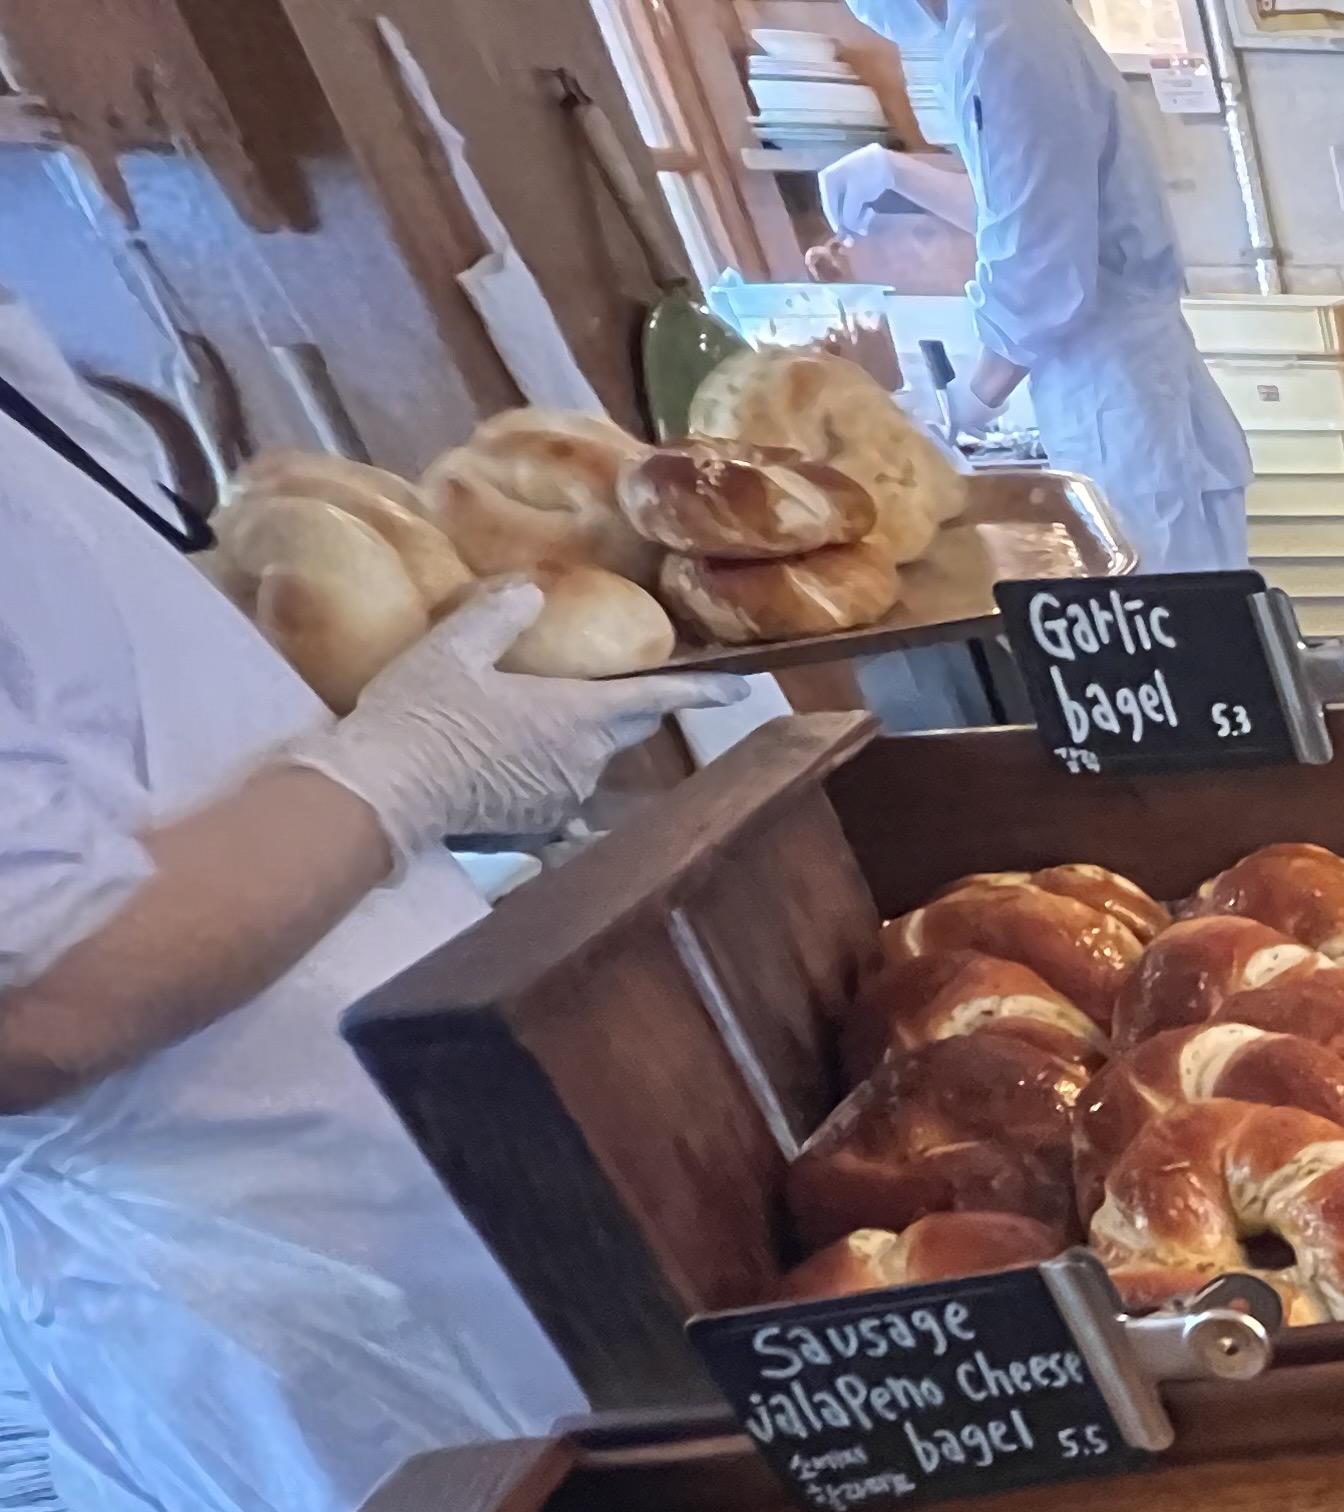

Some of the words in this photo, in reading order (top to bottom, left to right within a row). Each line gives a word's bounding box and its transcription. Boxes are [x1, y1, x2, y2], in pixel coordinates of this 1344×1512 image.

[1029, 590, 1177, 660] Garlic
[1050, 665, 1178, 742] bagel
[1211, 702, 1251, 737] 5.3
[753, 1301, 976, 1379] Sausage
[903, 1409, 1034, 1474] bagel
[1058, 1424, 1110, 1460] 5.5
